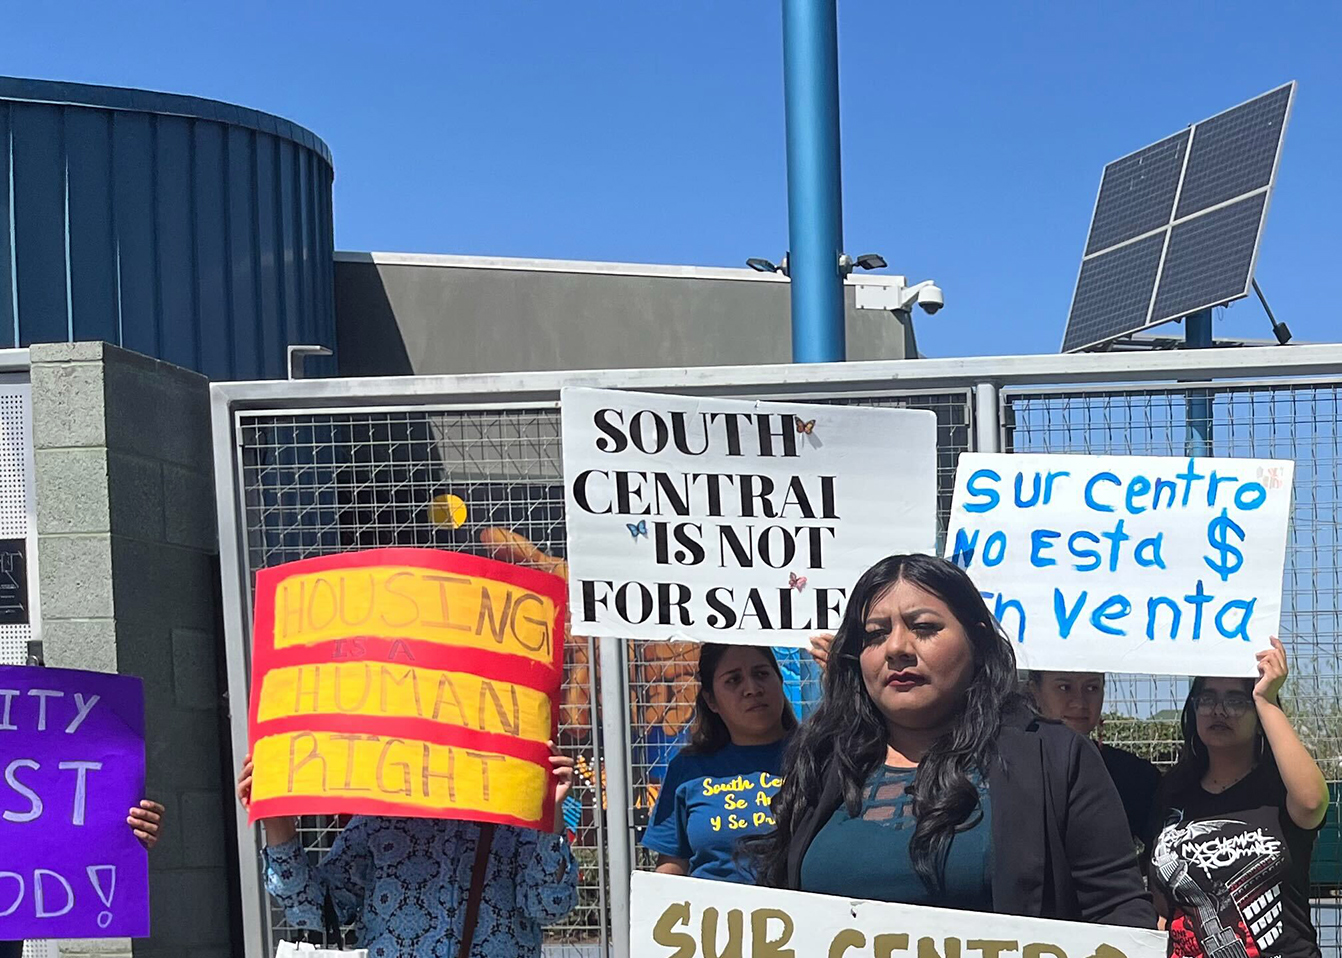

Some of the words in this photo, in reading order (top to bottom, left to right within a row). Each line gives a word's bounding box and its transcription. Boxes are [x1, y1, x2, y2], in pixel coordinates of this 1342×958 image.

[593, 408, 801, 457] SOUTH
[651, 521, 706, 566] IS
[716, 524, 836, 570] NOT
[282, 571, 552, 656] HOUSING
[577, 579, 695, 626] FOR
[705, 586, 847, 630] SALE
[330, 635, 367, 659] IS
[387, 638, 416, 661] A
[294, 664, 520, 737] HUMAN
[287, 730, 506, 803] RIGHT
[702, 775, 754, 796] South
[724, 793, 748, 810] Se
[728, 814, 748, 829] Se
